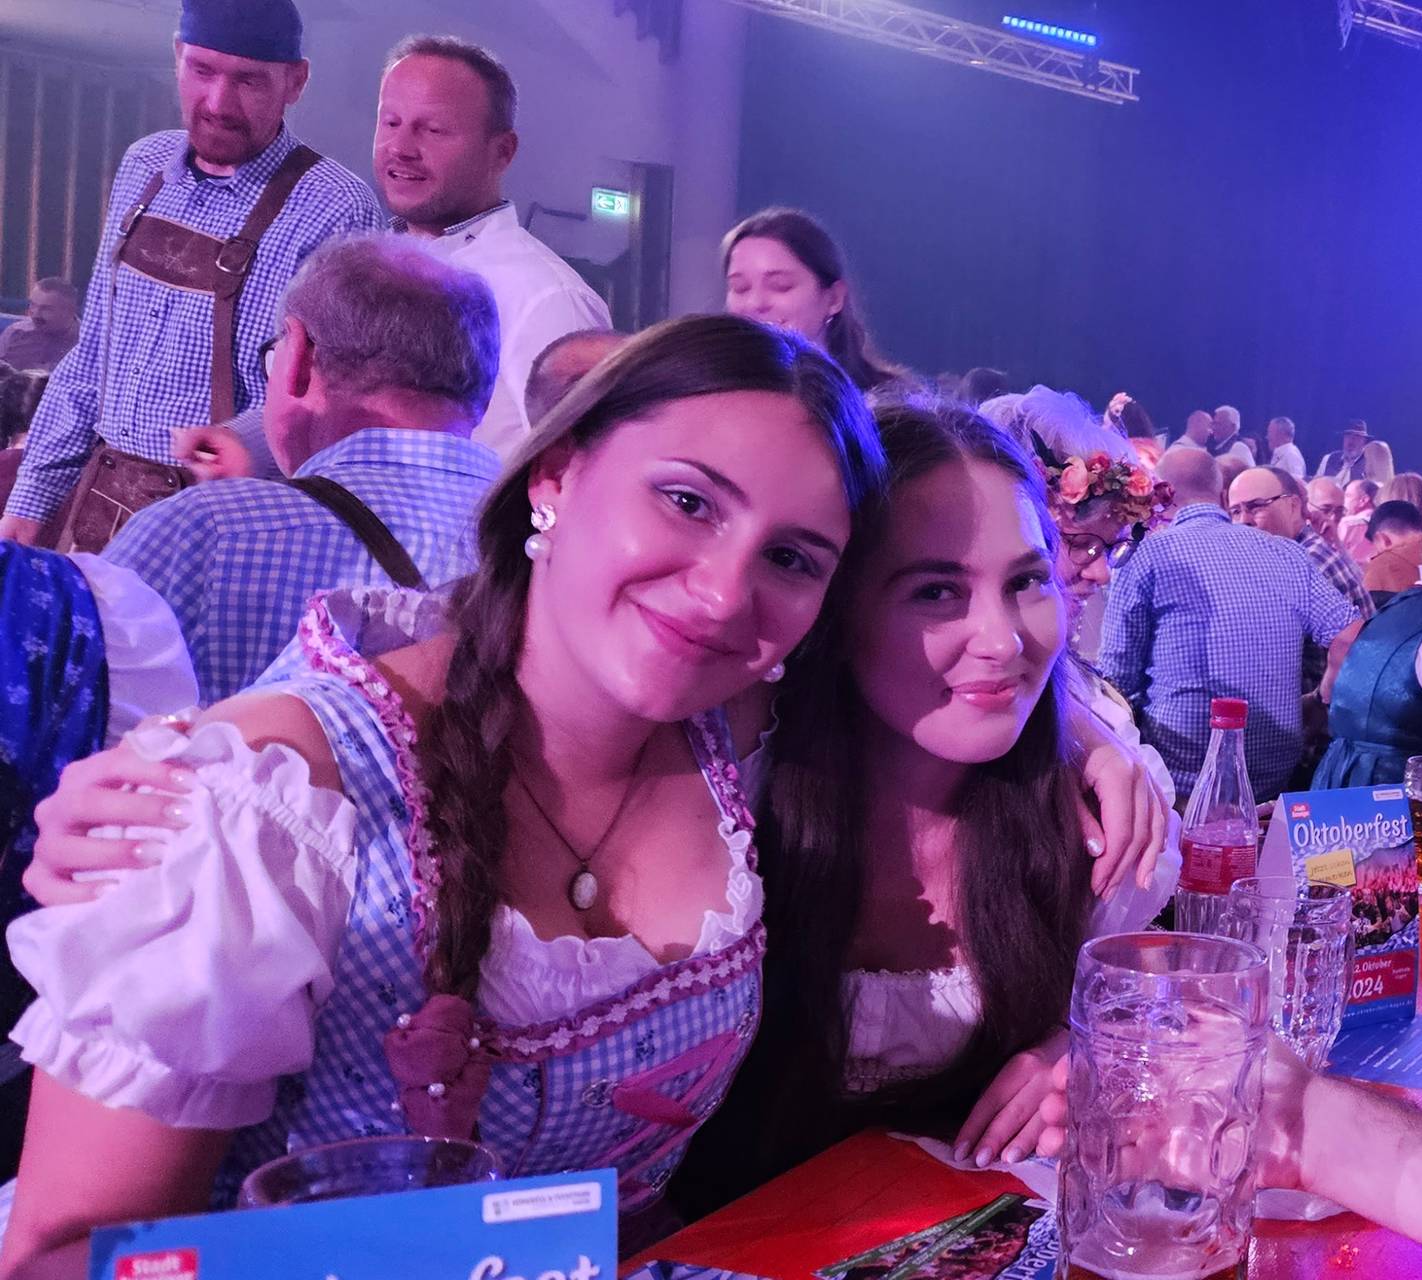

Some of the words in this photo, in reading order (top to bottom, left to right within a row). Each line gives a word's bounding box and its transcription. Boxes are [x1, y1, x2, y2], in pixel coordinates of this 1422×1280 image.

[1293, 812, 1408, 847] Oktoberfest
[1362, 959, 1392, 972] Oktober
[1347, 975, 1384, 999] 024
